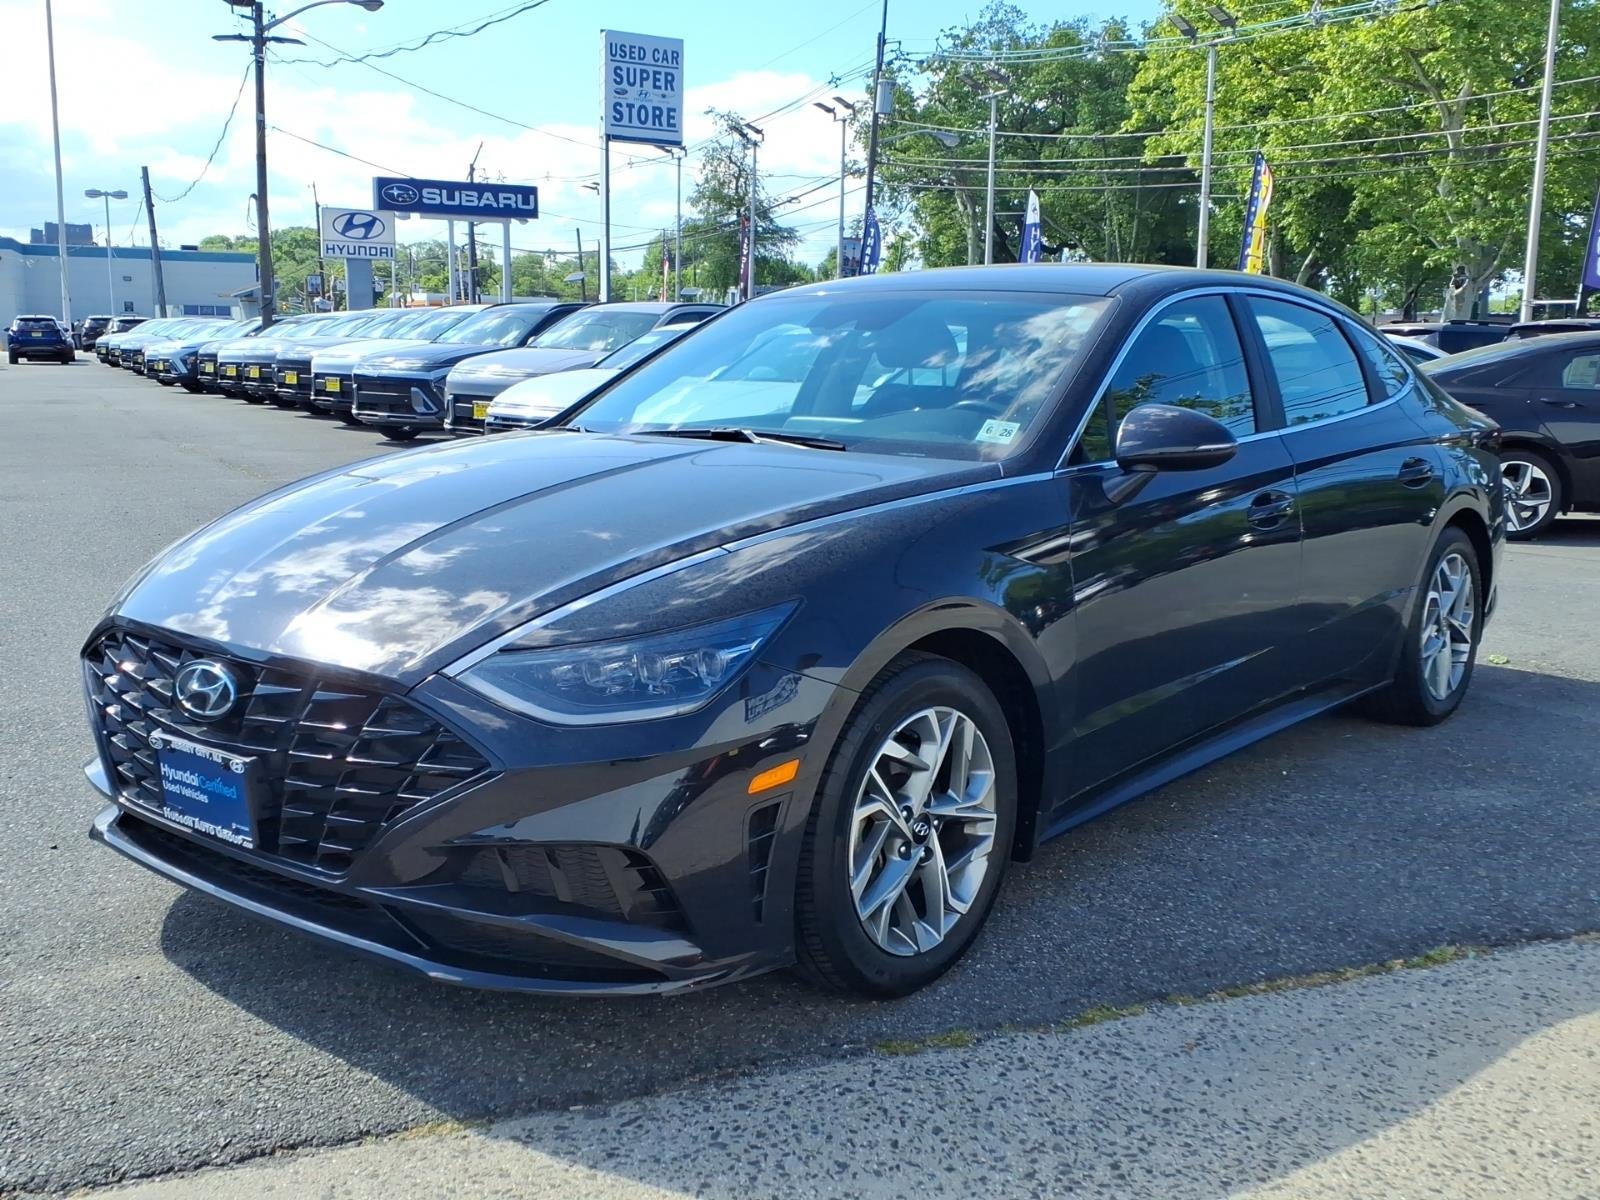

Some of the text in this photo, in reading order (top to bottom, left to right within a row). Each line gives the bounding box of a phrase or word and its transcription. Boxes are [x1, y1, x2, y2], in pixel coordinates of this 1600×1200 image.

[609, 42, 680, 65] USED CAR
[613, 65, 676, 92] SUPER
[612, 101, 677, 128] STORE
[422, 188, 535, 210] SUBARU
[325, 243, 393, 258] HYUNDAI
[985, 426, 1013, 437] 6 28
[162, 779, 209, 803] Used Vehicles
